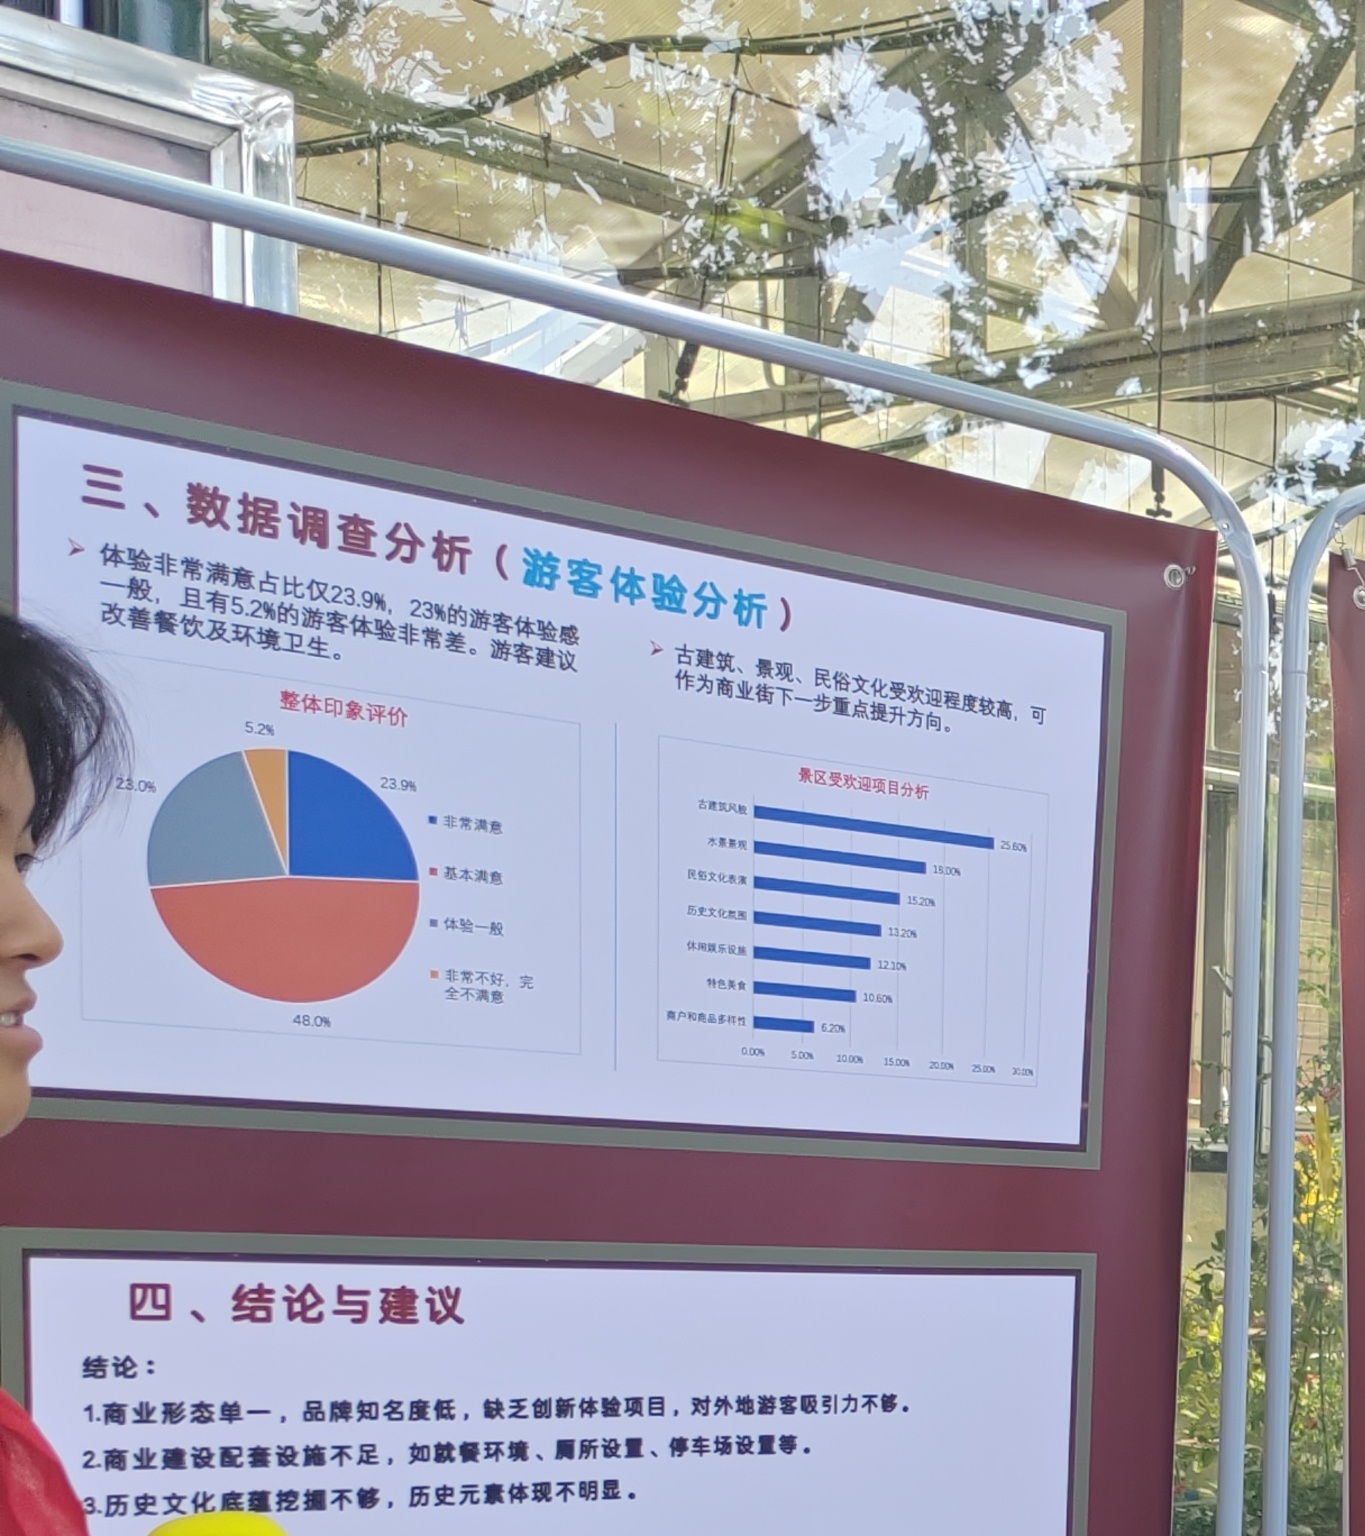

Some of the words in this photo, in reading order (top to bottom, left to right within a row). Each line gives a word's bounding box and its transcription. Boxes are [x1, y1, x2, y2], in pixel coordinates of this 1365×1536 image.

[81, 463, 793, 633] 三、数据调查分析（游客体验分析）
[100, 601, 344, 663] 改善餐饮及环境卫生。
[674, 645, 1047, 726] 古建筑、景观、民俗文化受欢迎程度较高，可
[279, 689, 408, 728] 整体印象评价
[674, 669, 954, 733] 作为商业街下一步重点提升方向。
[245, 721, 275, 736] 5.2%
[116, 776, 157, 794] 23.0%
[379, 776, 418, 793] 23.9%
[798, 767, 929, 801] 景区受欢迎项目分析
[443, 814, 503, 835] 非常满意
[443, 865, 503, 886] 基本满意
[443, 916, 504, 937] 体验一般
[293, 1013, 332, 1028] 48.0%
[128, 1281, 466, 1326] 四、结论与建议
[82, 1355, 157, 1380] 结论：
